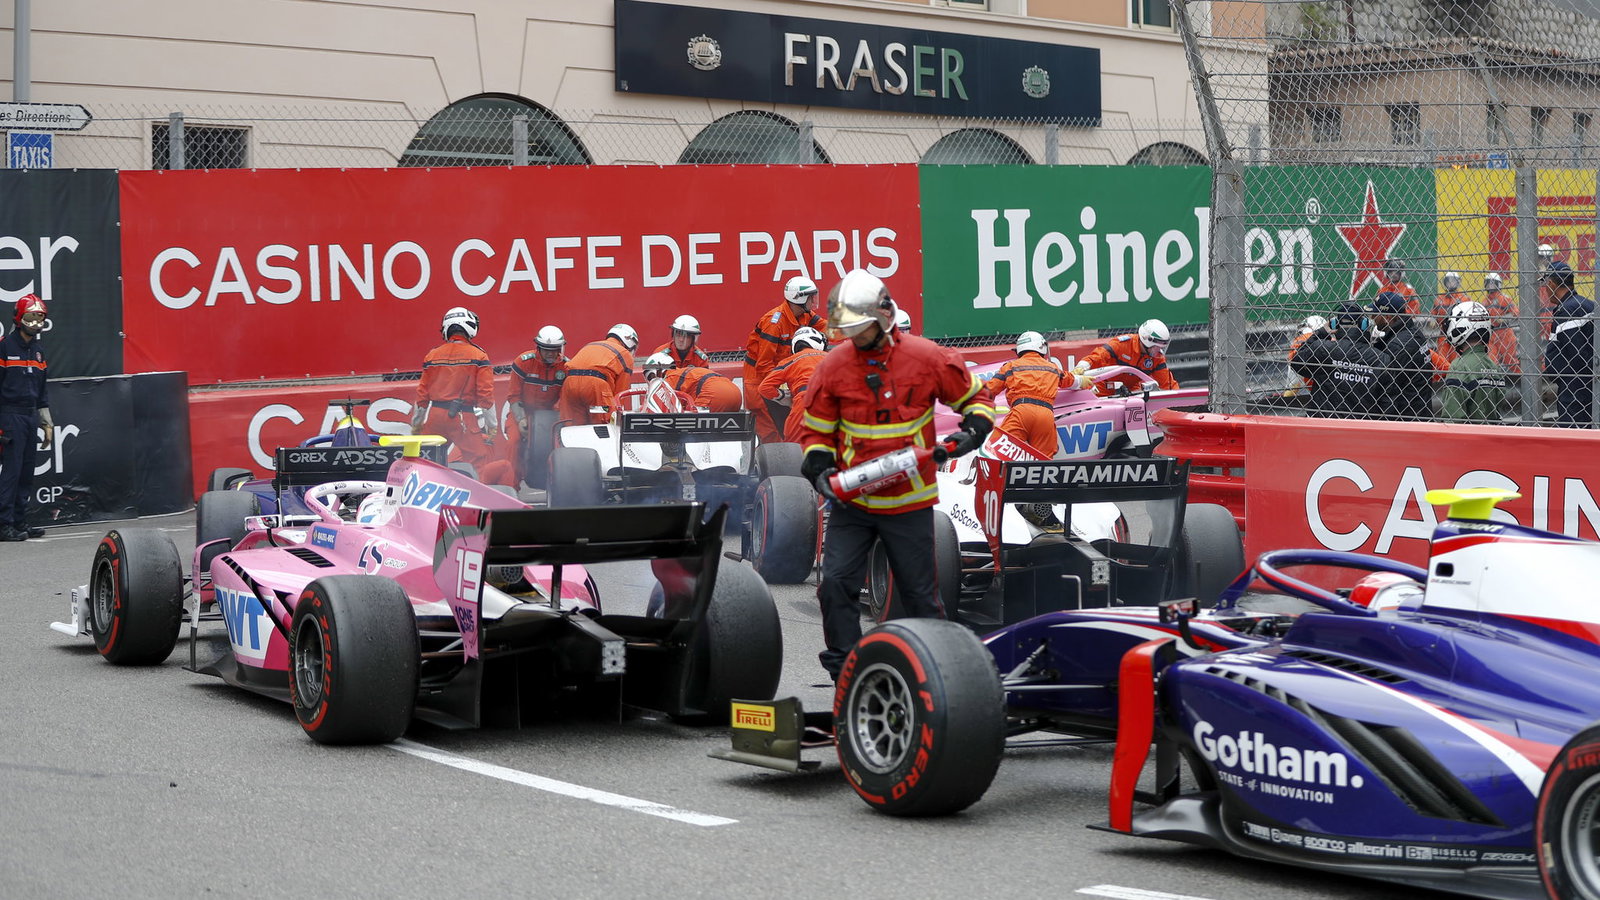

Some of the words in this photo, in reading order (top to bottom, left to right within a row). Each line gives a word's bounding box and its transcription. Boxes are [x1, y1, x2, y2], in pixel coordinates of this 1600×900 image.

[784, 33, 968, 100] FRASER
[16, 110, 71, 123] Directions
[14, 146, 50, 168] TAXIS
[150, 241, 430, 309] CASINO
[451, 235, 624, 296] CAFE
[642, 233, 723, 287] DE
[740, 227, 899, 283] PARIS
[971, 206, 1318, 308] Heineen
[1334, 371, 1370, 384] CIRCUIT
[631, 417, 740, 430] PREMA
[1057, 421, 1112, 454] WT
[289, 452, 328, 463] OREX
[332, 450, 388, 465] ADSS
[1009, 464, 1159, 485] PERTAMINA
[36, 486, 64, 503] GP
[983, 490, 999, 537] 10
[455, 548, 483, 603] 19
[918, 690, 934, 712] P
[736, 709, 771, 727] PIRELLI
[891, 723, 934, 800] ZERO
[1194, 720, 1364, 788] Gotham.
[1218, 771, 1243, 788] STATE
[1261, 781, 1334, 804] INNOVATION
[1348, 842, 1402, 857] allegrini
[1432, 848, 1477, 857] BISELLO
